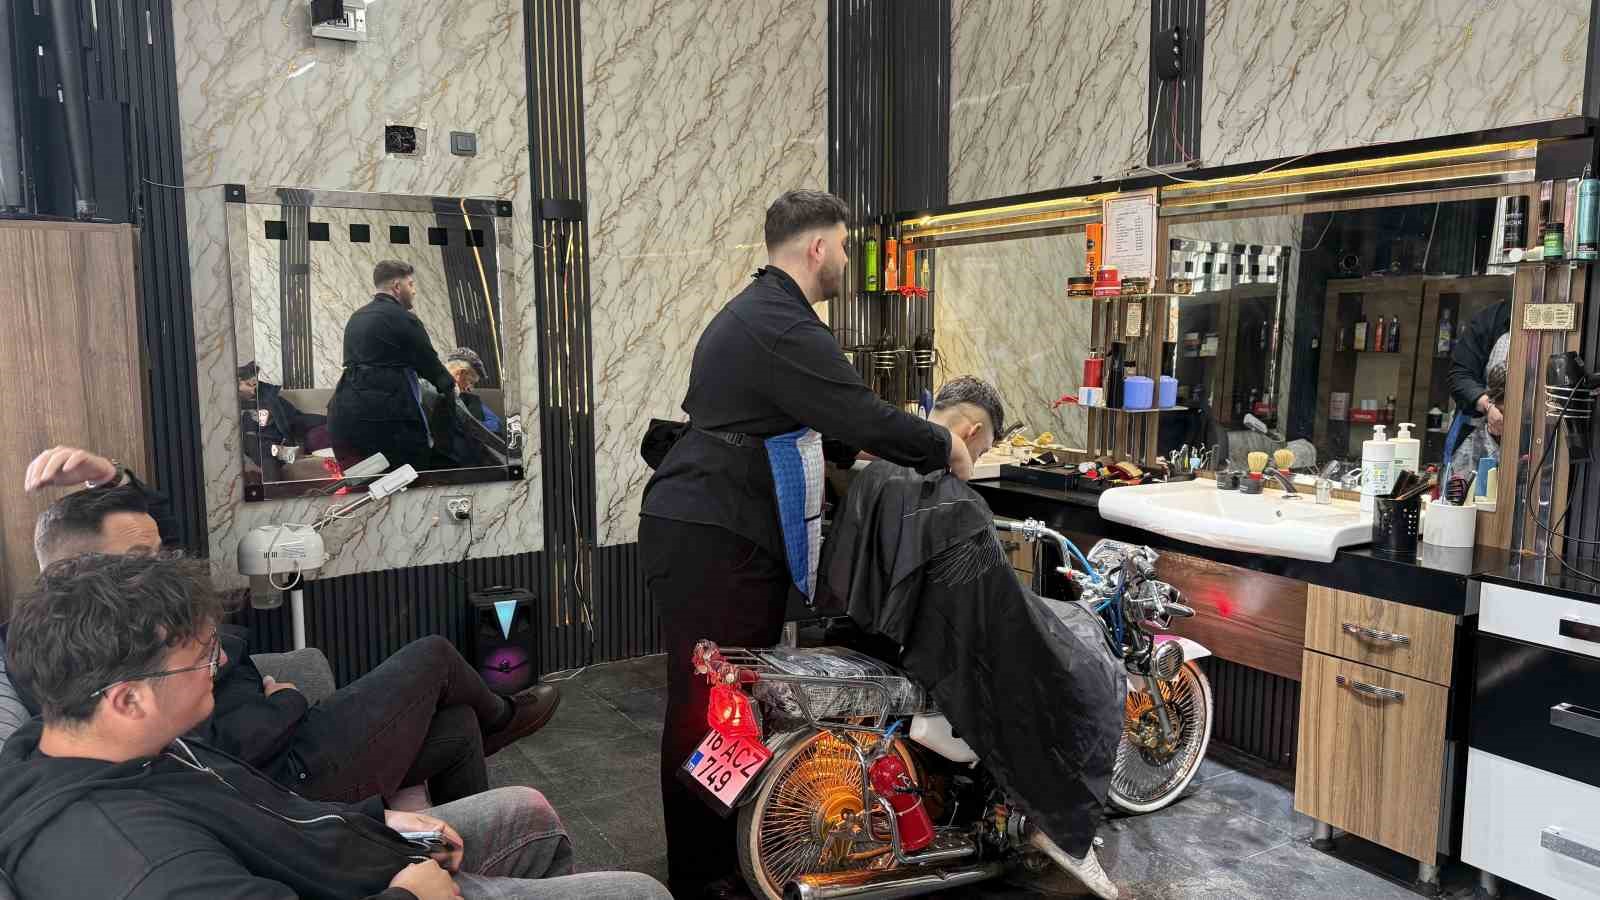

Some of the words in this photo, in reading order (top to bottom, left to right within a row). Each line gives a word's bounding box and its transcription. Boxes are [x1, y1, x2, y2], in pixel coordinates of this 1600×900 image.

[697, 755, 732, 792] 749
[706, 730, 724, 751] 16
[720, 740, 764, 778] ACZ
